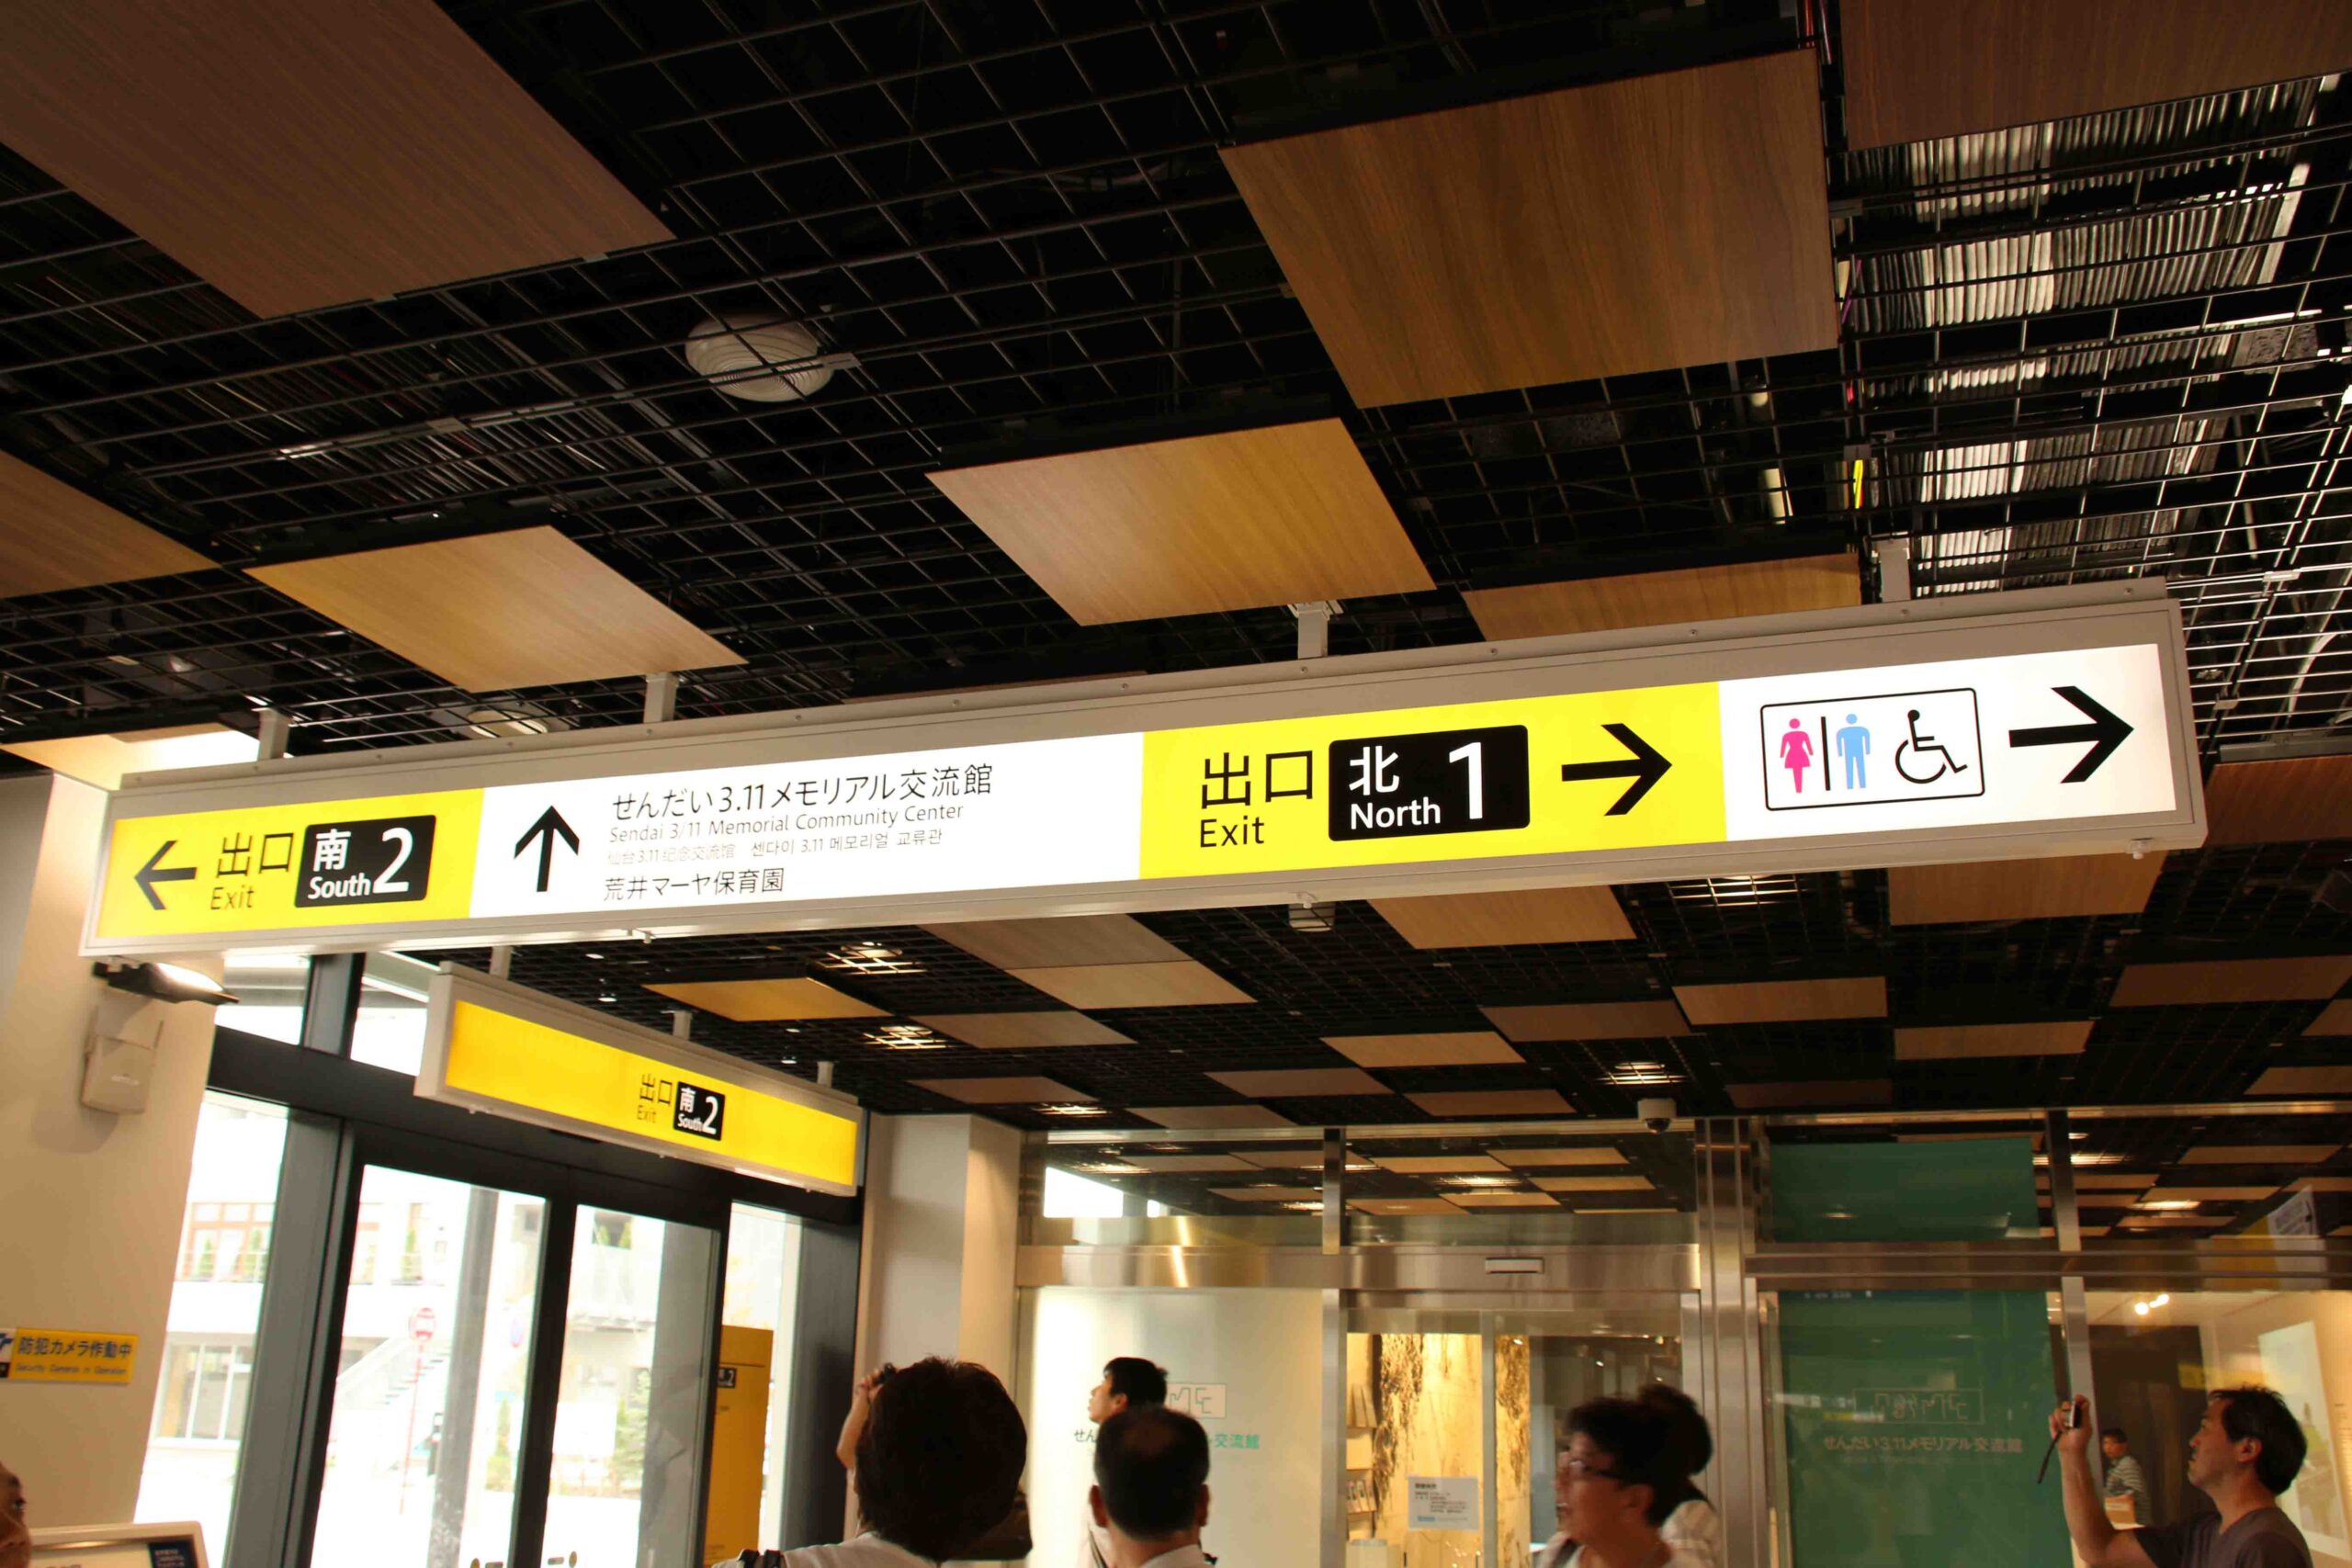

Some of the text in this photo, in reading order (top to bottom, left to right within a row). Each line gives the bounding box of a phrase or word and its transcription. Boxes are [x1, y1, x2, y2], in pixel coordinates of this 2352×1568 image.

[1201, 750, 1313, 809] 出口
[1349, 745, 1400, 796] 北
[1449, 741, 1484, 819] 1
[613, 763, 992, 820] せんだい3.11メモリアル交流館
[610, 823, 663, 842] Sendai
[708, 816, 788, 835] Memorial
[796, 807, 899, 829] Community
[904, 804, 964, 822] Center
[1350, 796, 1441, 829] North
[312, 829, 352, 872] 南
[801, 838, 824, 852] 3.11
[830, 832, 888, 852] 메모리얼
[897, 829, 943, 846] 교류관
[1200, 816, 1265, 848] Exit
[216, 832, 294, 878] 出口
[373, 827, 413, 895] 2
[210, 886, 254, 910] Exit
[308, 874, 370, 899] South
[604, 868, 784, 901] 荒井マーヤ保育園
[639, 1073, 673, 1106] 出口
[677, 1113, 704, 1133] South
[703, 1096, 718, 1135] 2
